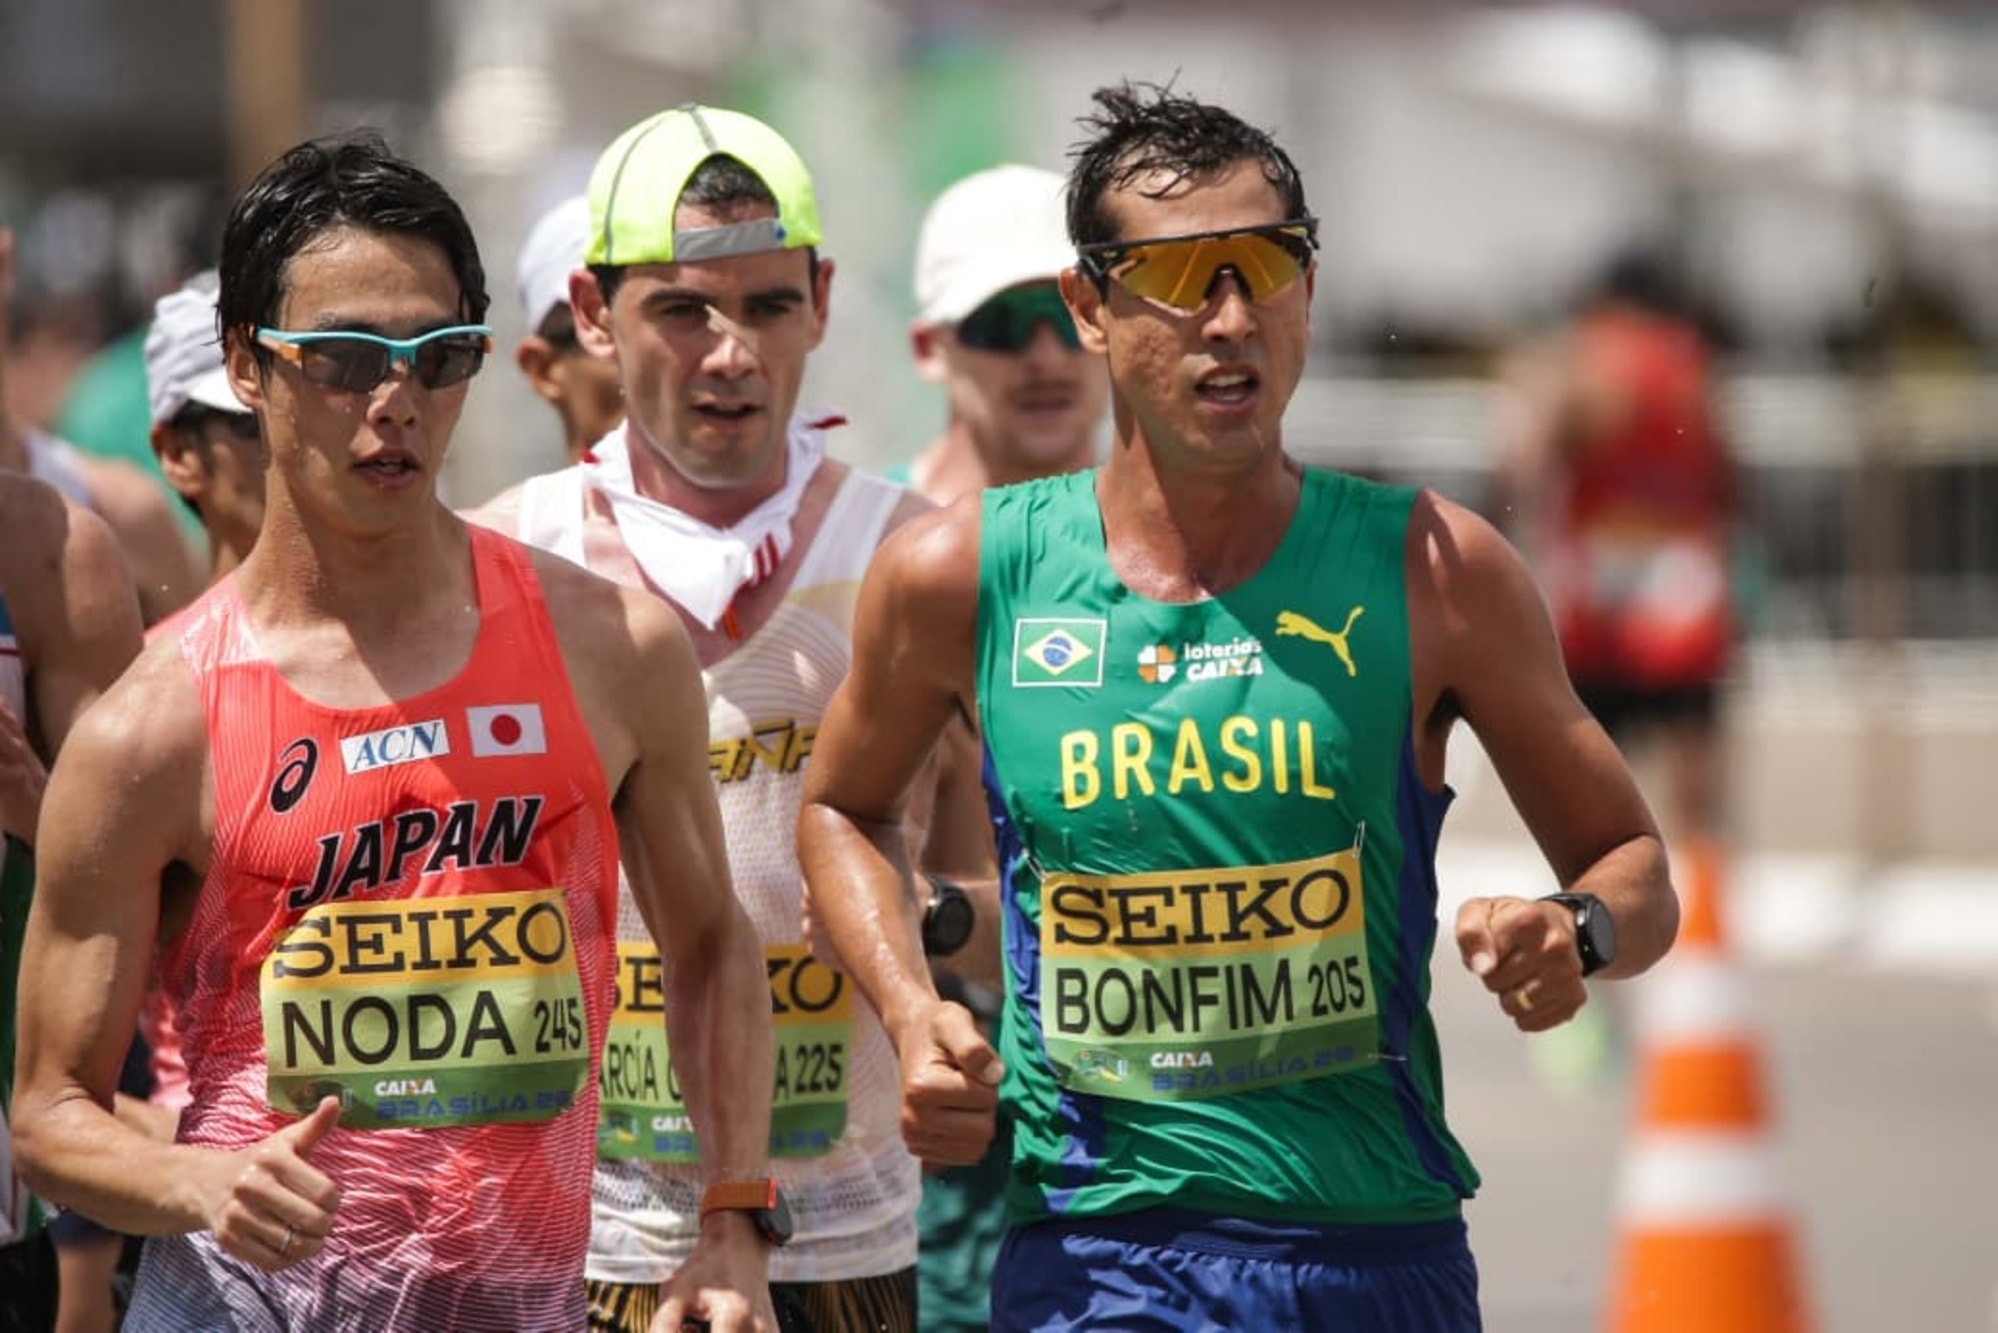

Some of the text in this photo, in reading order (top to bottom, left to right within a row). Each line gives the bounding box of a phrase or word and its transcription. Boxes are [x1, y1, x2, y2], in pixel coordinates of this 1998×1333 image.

[1184, 636, 1262, 661] loterias
[1186, 656, 1264, 682] CAIXA
[352, 721, 441, 771] ACN
[1059, 715, 1335, 811] BRASIL
[286, 795, 545, 911] JAPAN
[1050, 869, 1350, 946] SEIKO
[273, 901, 567, 979] SEIKO
[1055, 955, 1366, 1036] BONFIM 205
[281, 990, 582, 1068] NODA 245
[794, 1043, 844, 1095] 225
[1150, 1051, 1214, 1068] CAIXA
[374, 1078, 437, 1097] CAIXA
[375, 1091, 529, 1120] BRASÍLIA
